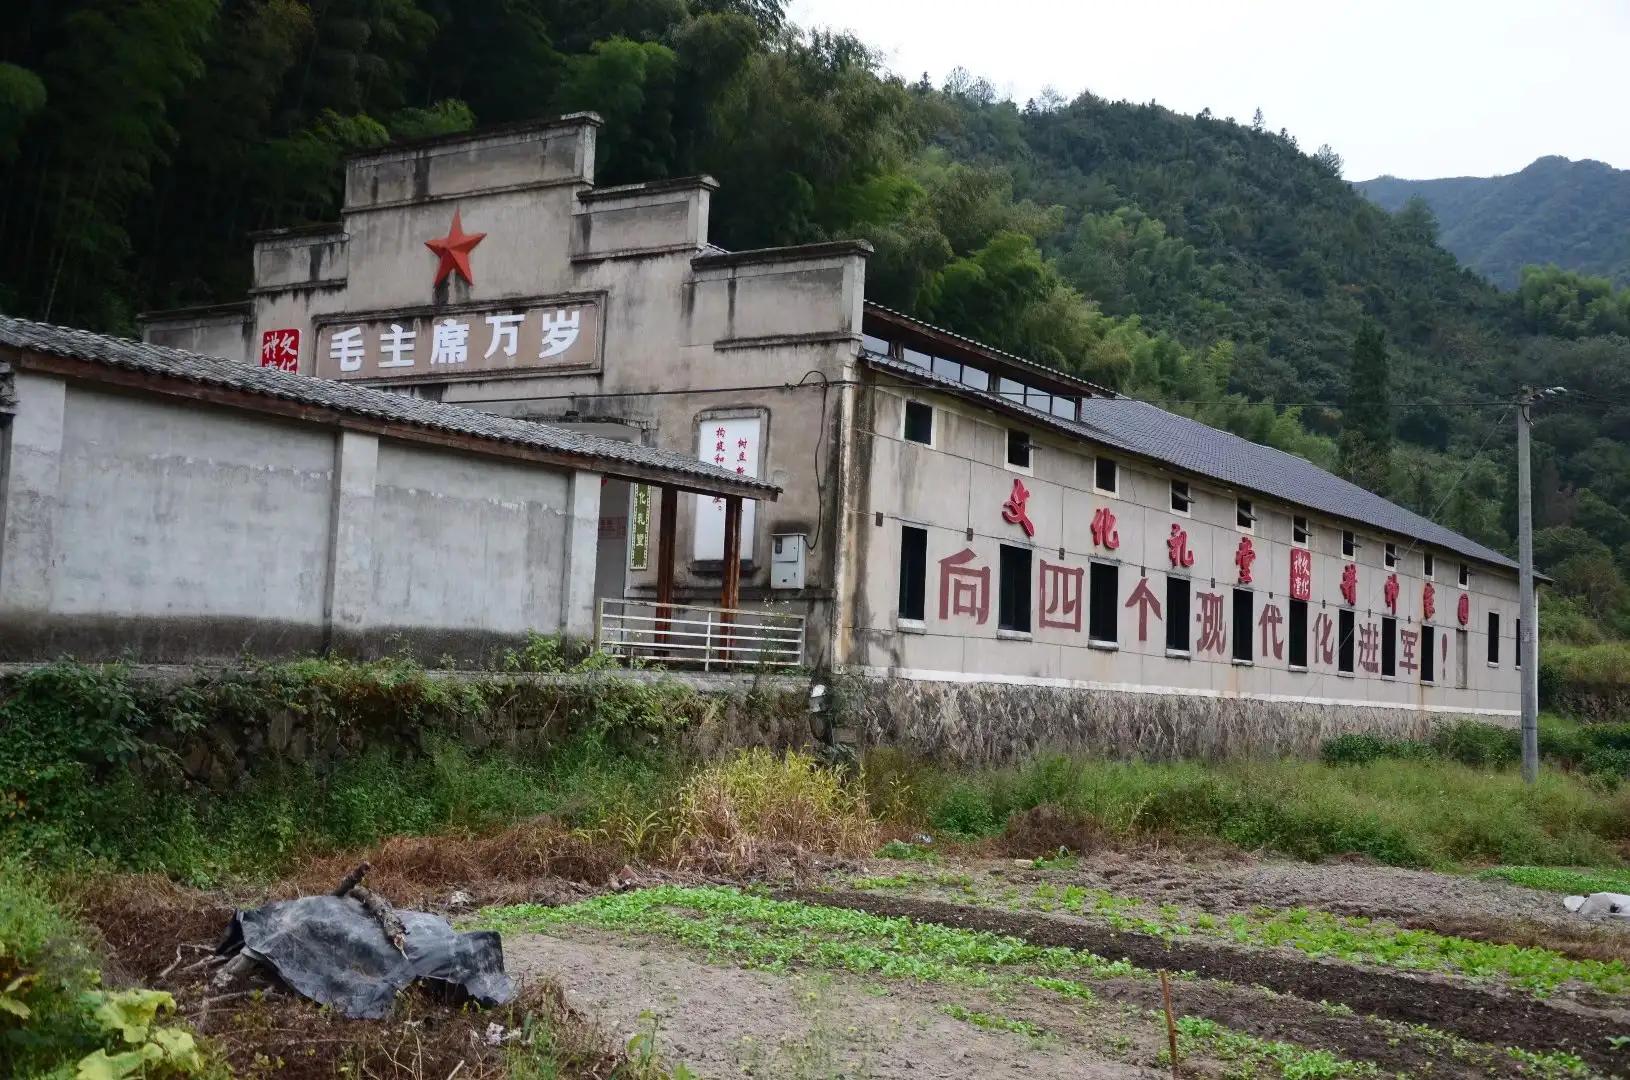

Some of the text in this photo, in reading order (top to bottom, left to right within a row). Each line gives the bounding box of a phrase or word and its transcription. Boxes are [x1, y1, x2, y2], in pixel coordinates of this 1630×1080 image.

[330, 310, 580, 372] 毛主席万岁
[1001, 478, 1256, 584] 文化礼堂
